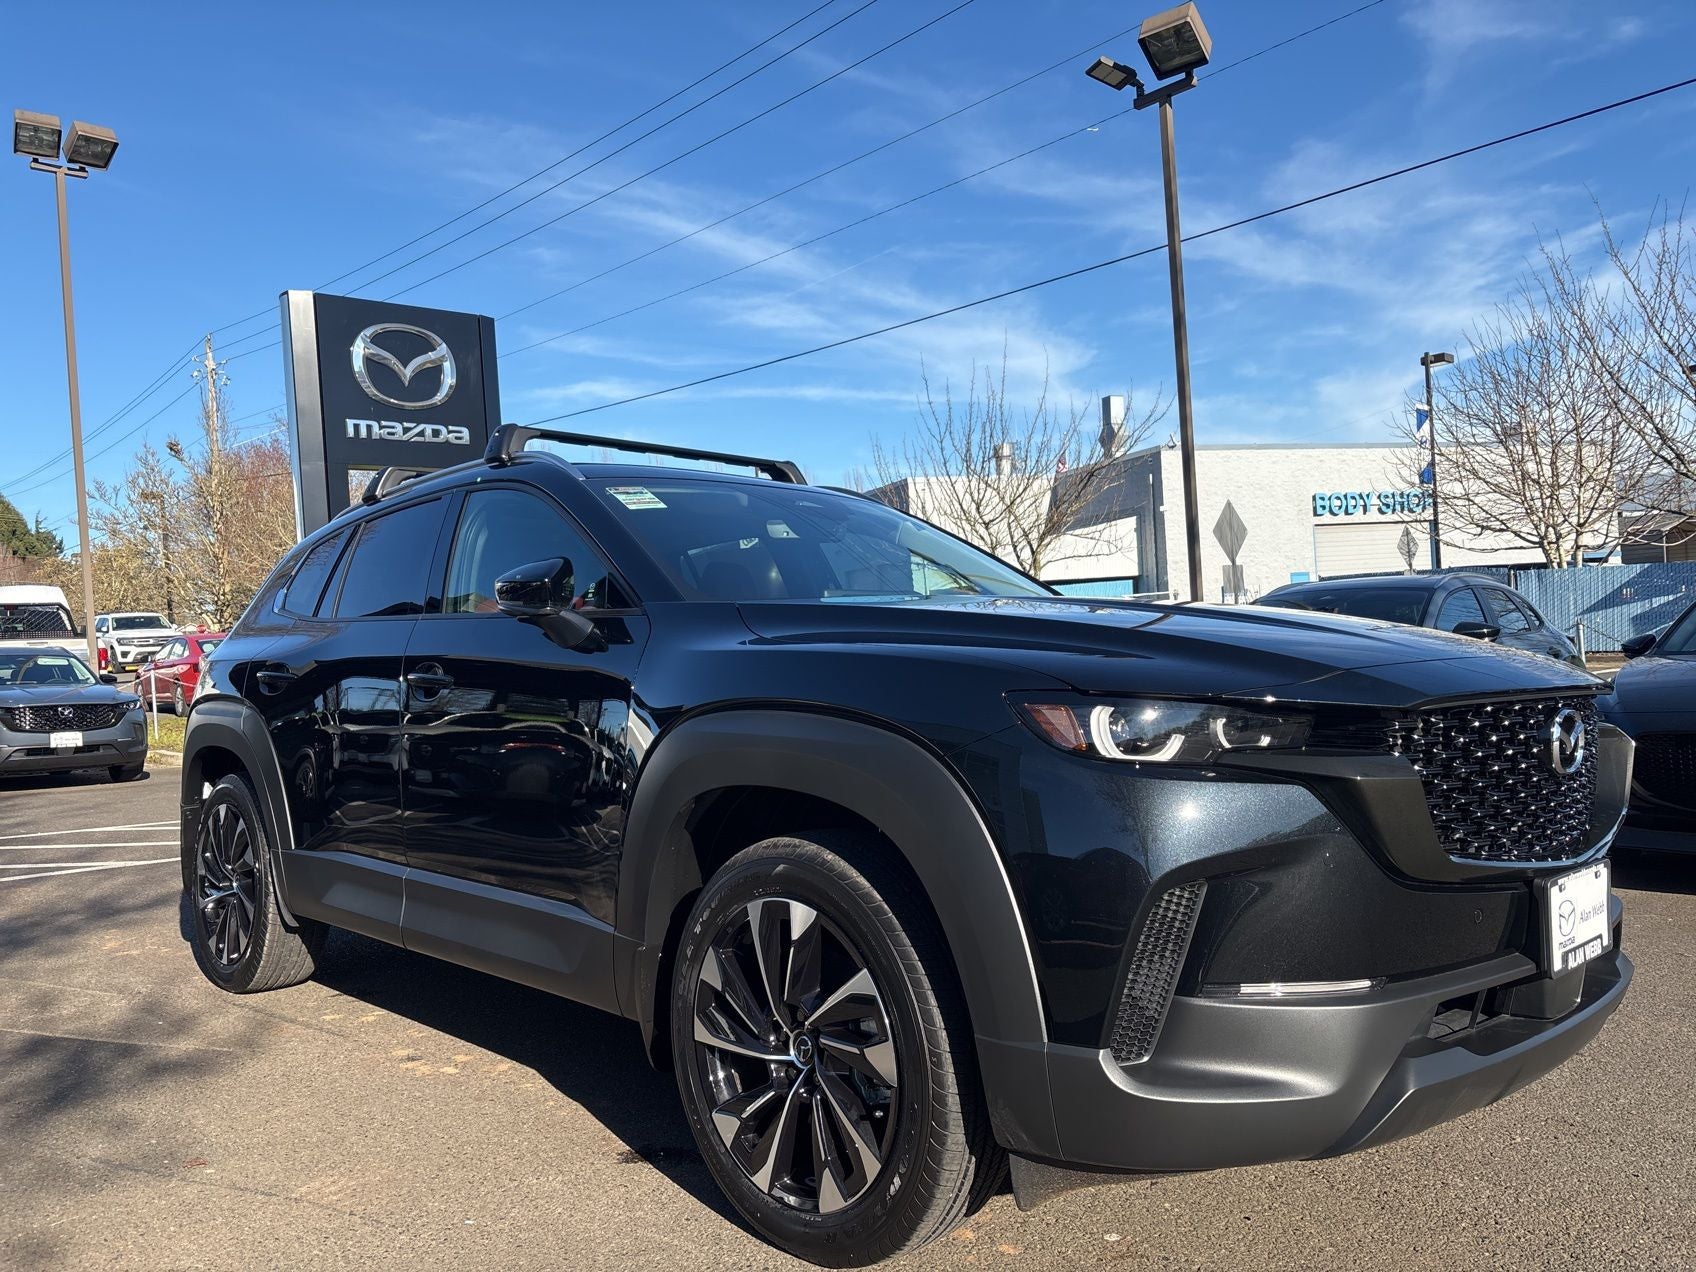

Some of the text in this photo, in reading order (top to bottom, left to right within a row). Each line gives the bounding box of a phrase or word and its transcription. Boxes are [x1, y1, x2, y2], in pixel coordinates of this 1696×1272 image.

[1313, 491, 1374, 517] BODY
[1568, 938, 1602, 970] ALAN WEBB
